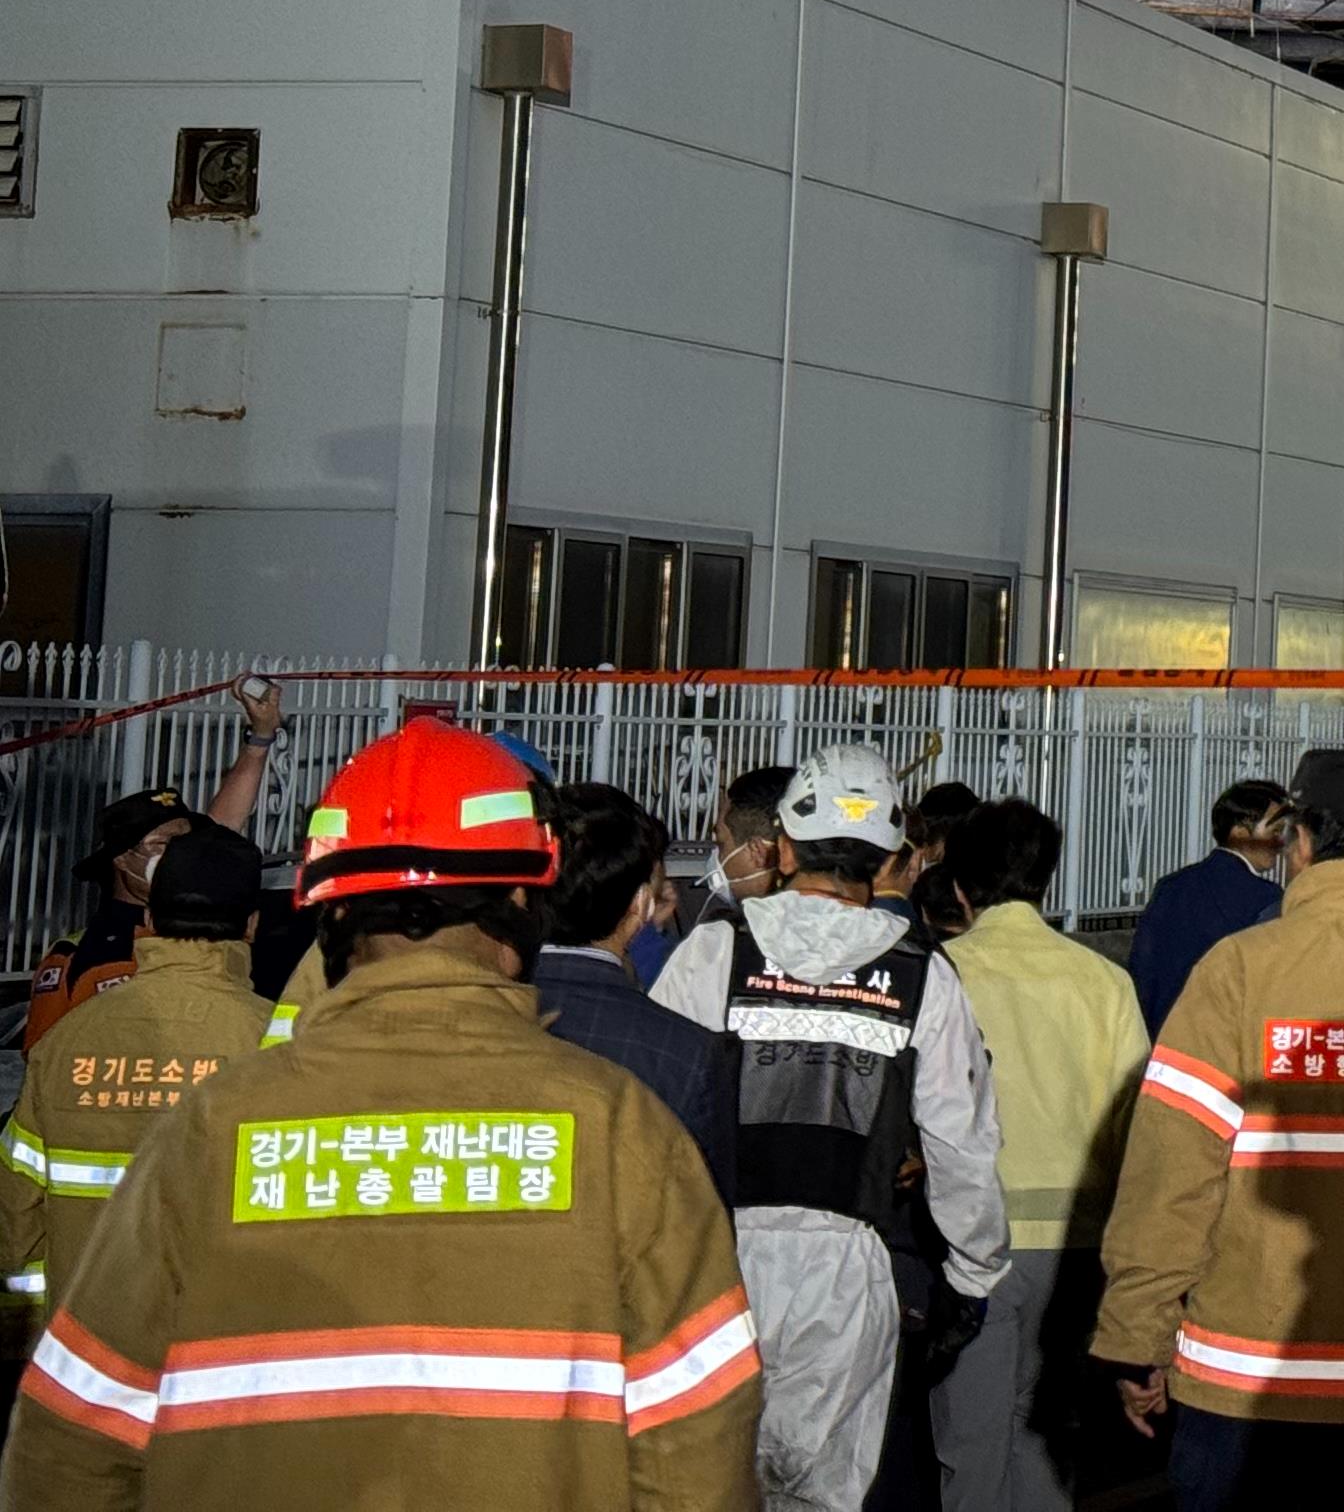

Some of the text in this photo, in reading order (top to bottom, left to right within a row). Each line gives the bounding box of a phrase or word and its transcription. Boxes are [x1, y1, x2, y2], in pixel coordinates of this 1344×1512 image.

[747, 976, 773, 990] Fire
[776, 979, 816, 996] Scene
[250, 1122, 559, 1168] 경기-본부 재난대응
